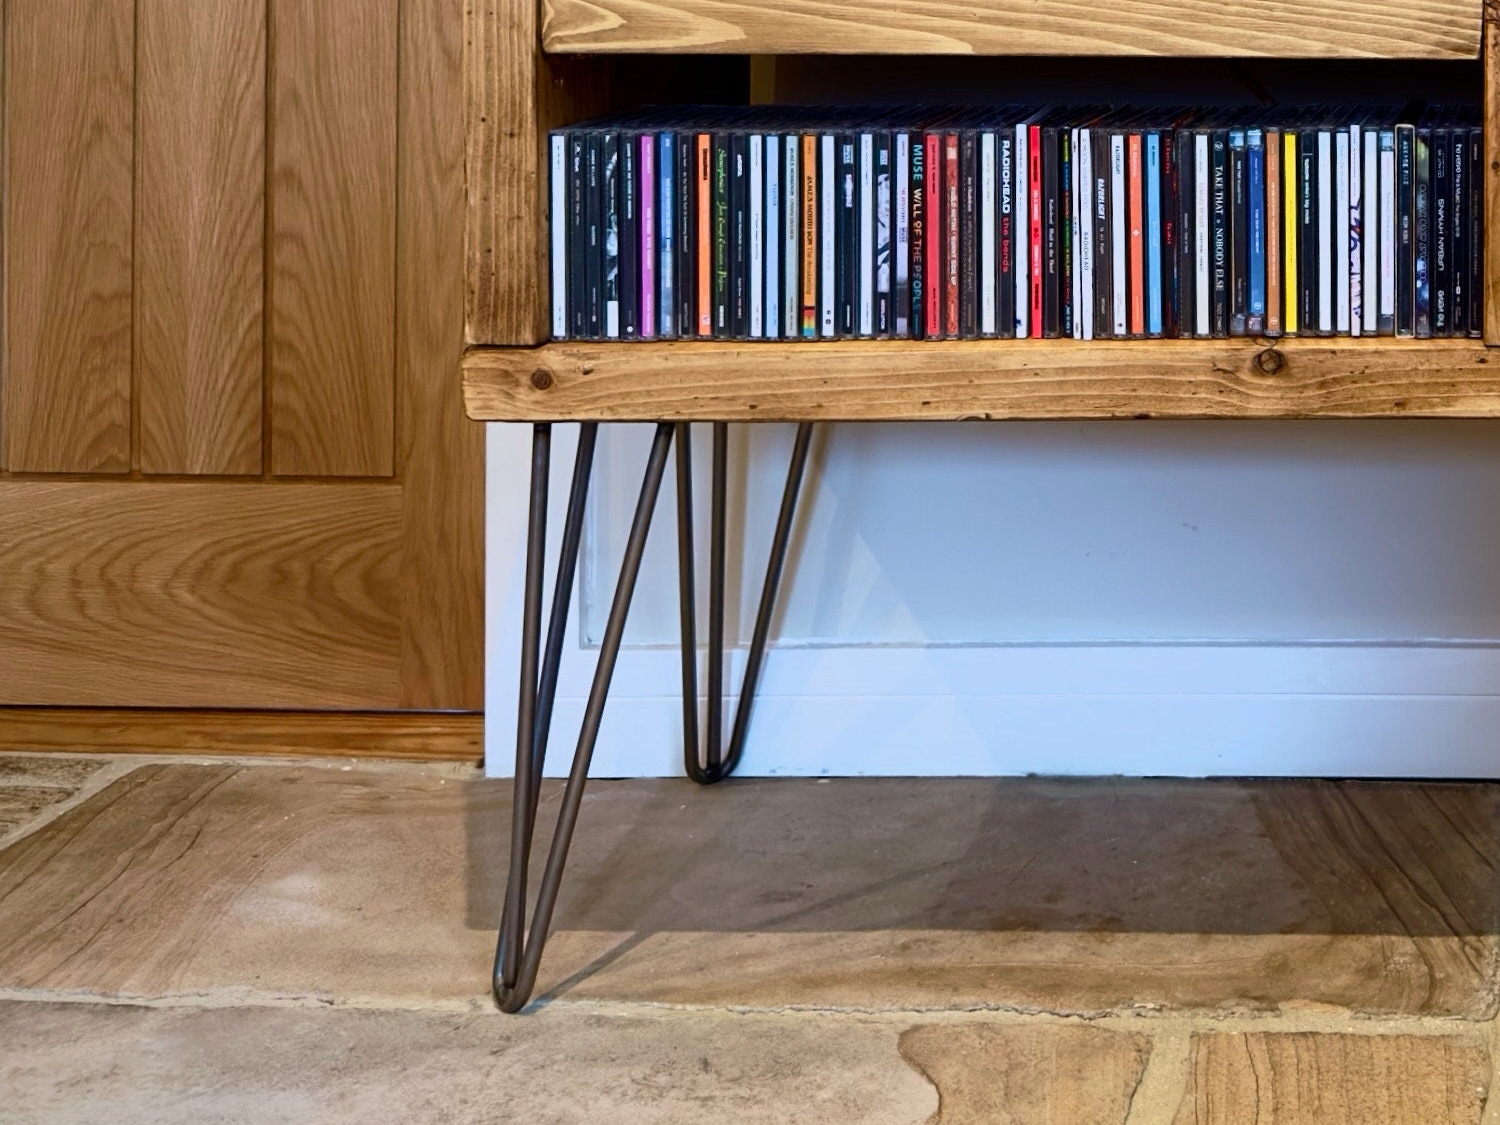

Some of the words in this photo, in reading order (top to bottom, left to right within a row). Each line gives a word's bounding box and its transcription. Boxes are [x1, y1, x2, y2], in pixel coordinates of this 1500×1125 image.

[913, 145, 922, 181] MUSE
[1002, 140, 1010, 214] RADIOHEAD
[1215, 165, 1223, 189] TAKE
[913, 188, 922, 217] WILL
[1215, 191, 1224, 214] THAT
[1437, 198, 1445, 234] HYMNS
[913, 221, 922, 235] OF
[913, 240, 921, 262] THE
[1215, 228, 1224, 267] NOBODY
[1437, 237, 1445, 271] URBAN
[913, 266, 921, 310] PEOPLE
[951, 276, 956, 286] UP
[1216, 269, 1224, 291] ELSE
